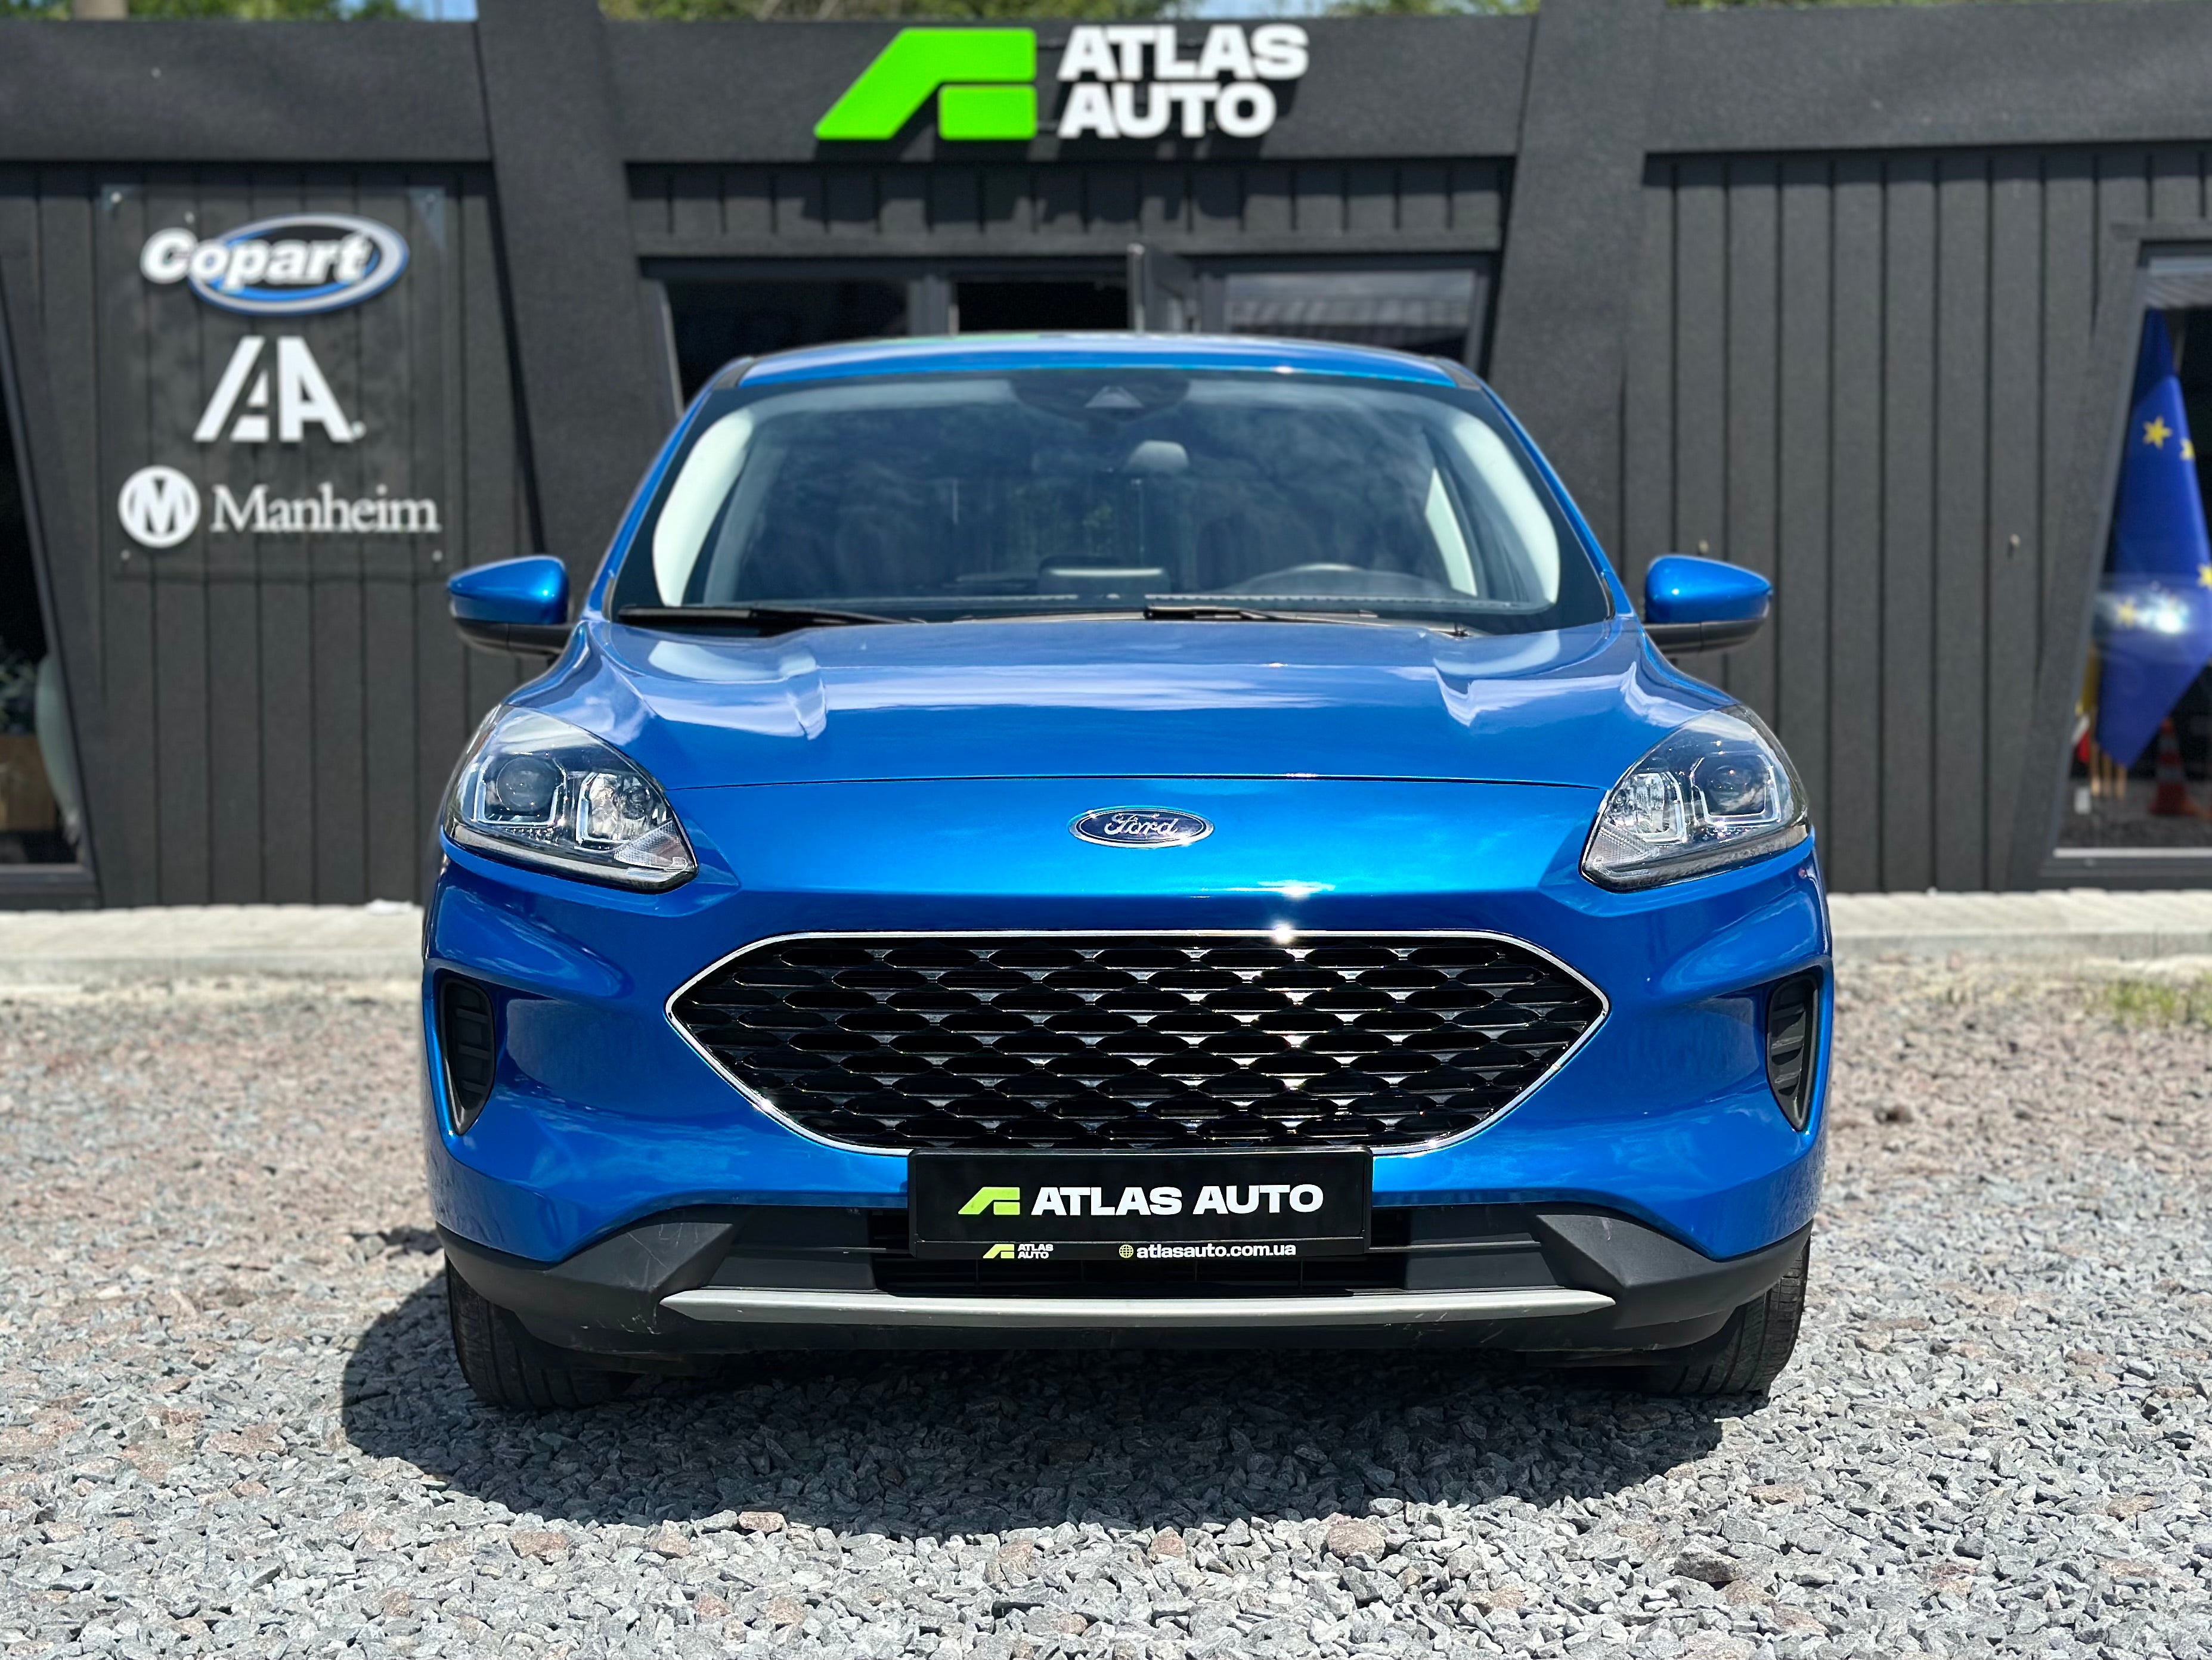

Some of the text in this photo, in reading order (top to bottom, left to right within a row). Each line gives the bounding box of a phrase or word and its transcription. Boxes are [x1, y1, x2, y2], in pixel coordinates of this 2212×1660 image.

[1058, 24, 1309, 80] ATLAS
[1058, 83, 1277, 139] AUTO
[140, 228, 372, 290] Copart
[210, 482, 441, 532] Manheim
[1104, 812, 1179, 835] Ford
[1030, 1184, 1324, 1216] ATLAS AUTO
[1136, 1243, 1297, 1259] atlasauto.com.ua
